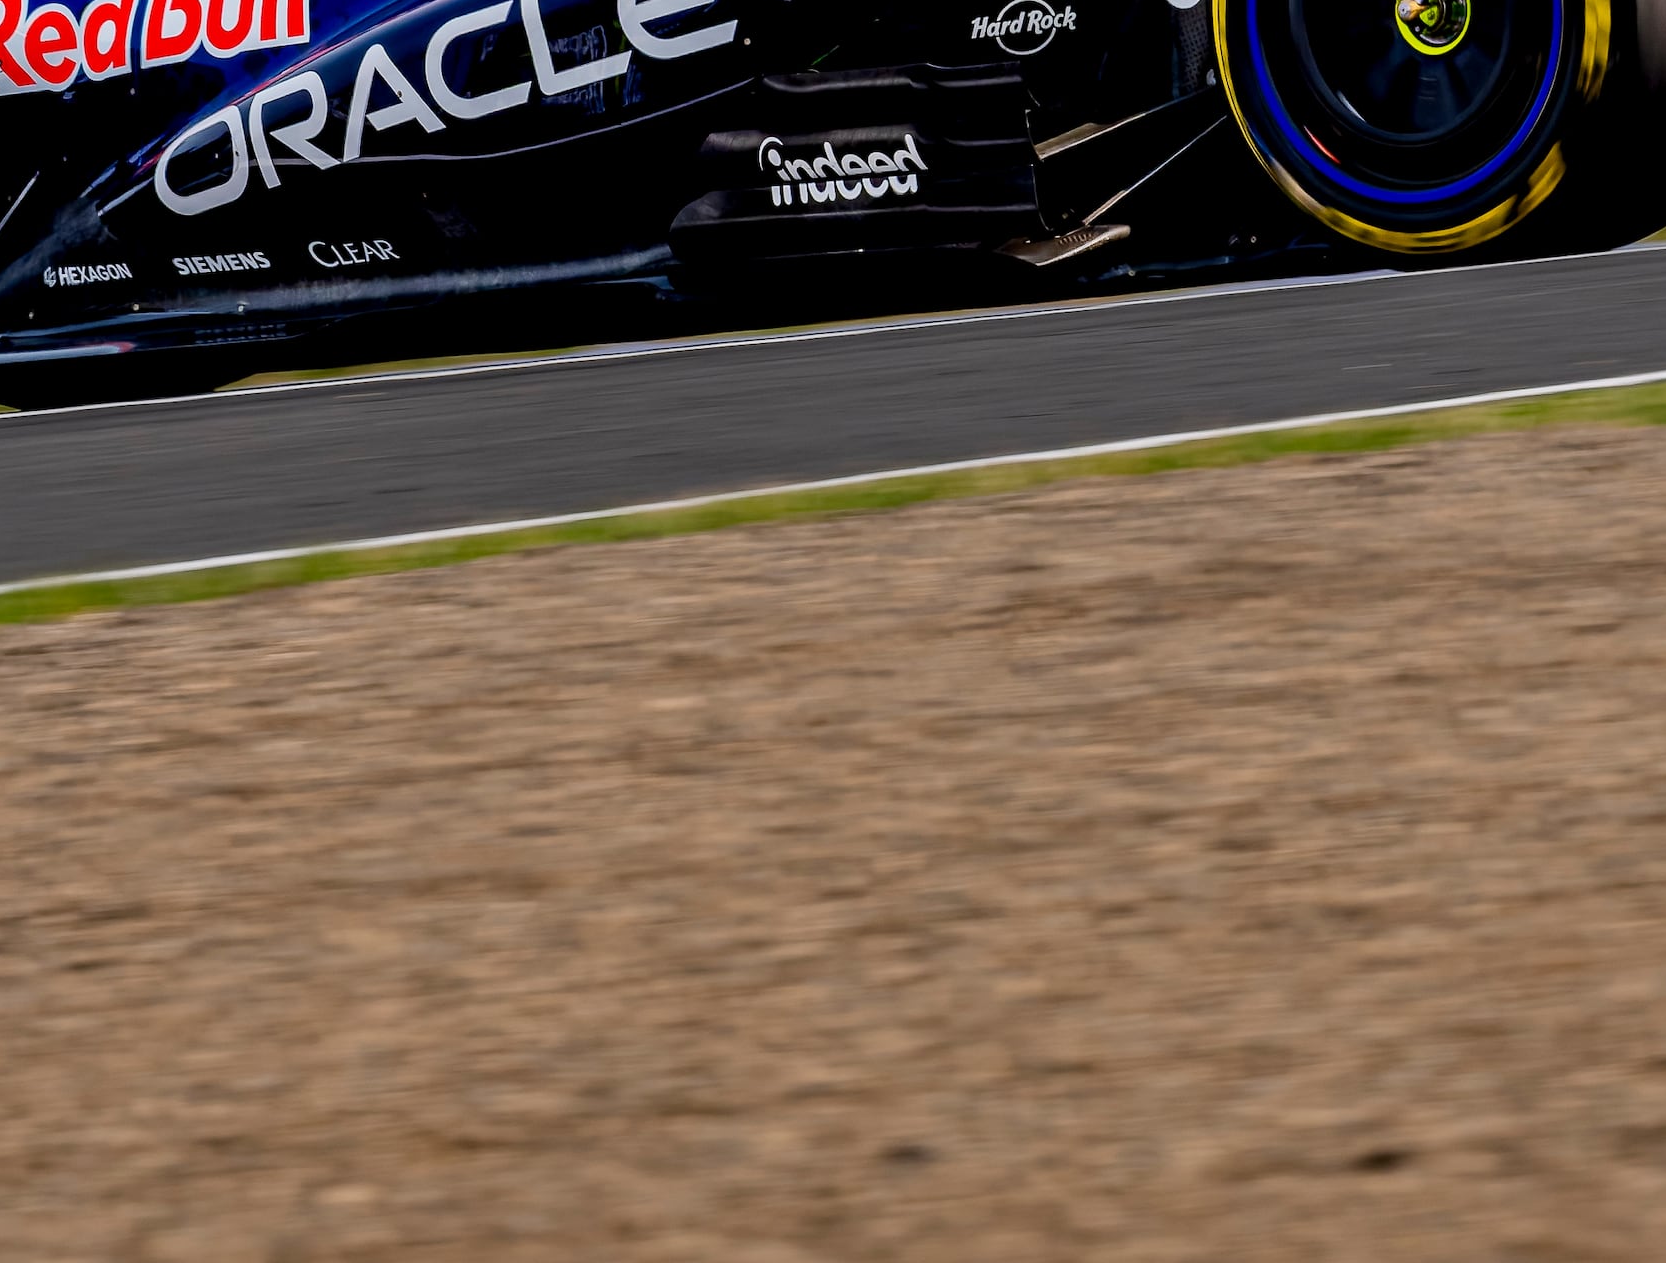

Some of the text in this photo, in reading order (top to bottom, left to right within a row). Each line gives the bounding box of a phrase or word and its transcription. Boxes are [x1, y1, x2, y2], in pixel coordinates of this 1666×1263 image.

[971, 5, 1077, 39] Hard Rock
[759, 134, 929, 206] indeed
[172, 251, 272, 276] SIEMENS
[307, 239, 401, 268] CLEAR
[59, 263, 133, 287] HEXAGON
